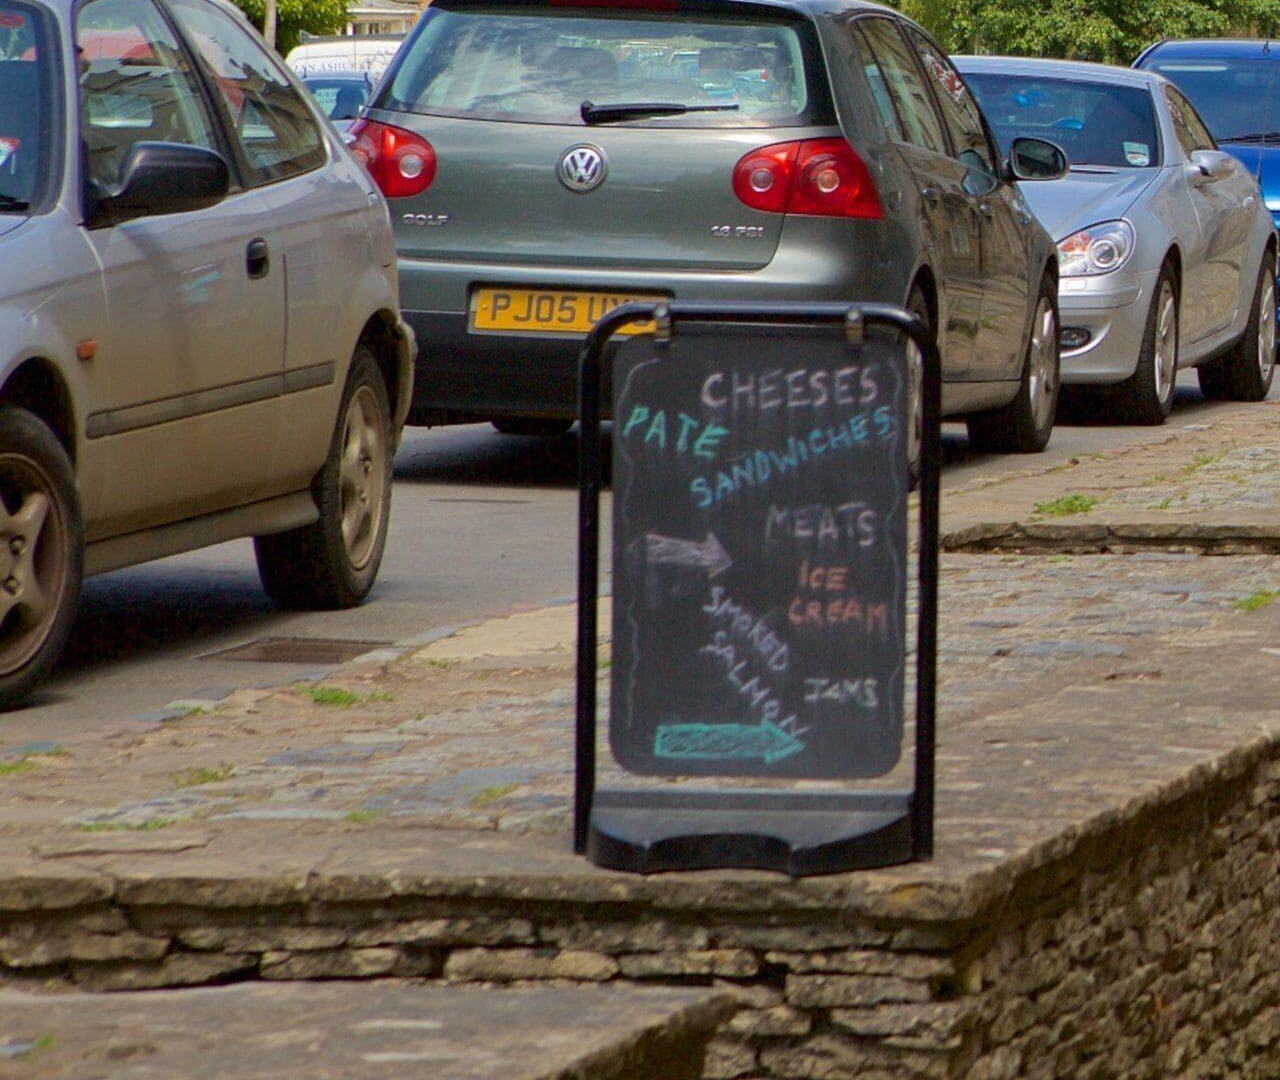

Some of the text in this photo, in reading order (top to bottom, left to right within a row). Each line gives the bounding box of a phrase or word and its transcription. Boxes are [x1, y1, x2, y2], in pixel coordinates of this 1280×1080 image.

[402, 213, 448, 226] GOLF
[702, 367, 879, 407] CHEESES
[622, 405, 731, 459] PATE
[690, 405, 898, 509] SANDWICHES
[766, 500, 877, 548] MEATS
[800, 558, 849, 591] ICE
[702, 585, 791, 673] SMOKED
[787, 596, 888, 634] CREAM
[699, 629, 812, 740] SALMON
[803, 677, 880, 709] JAMS
